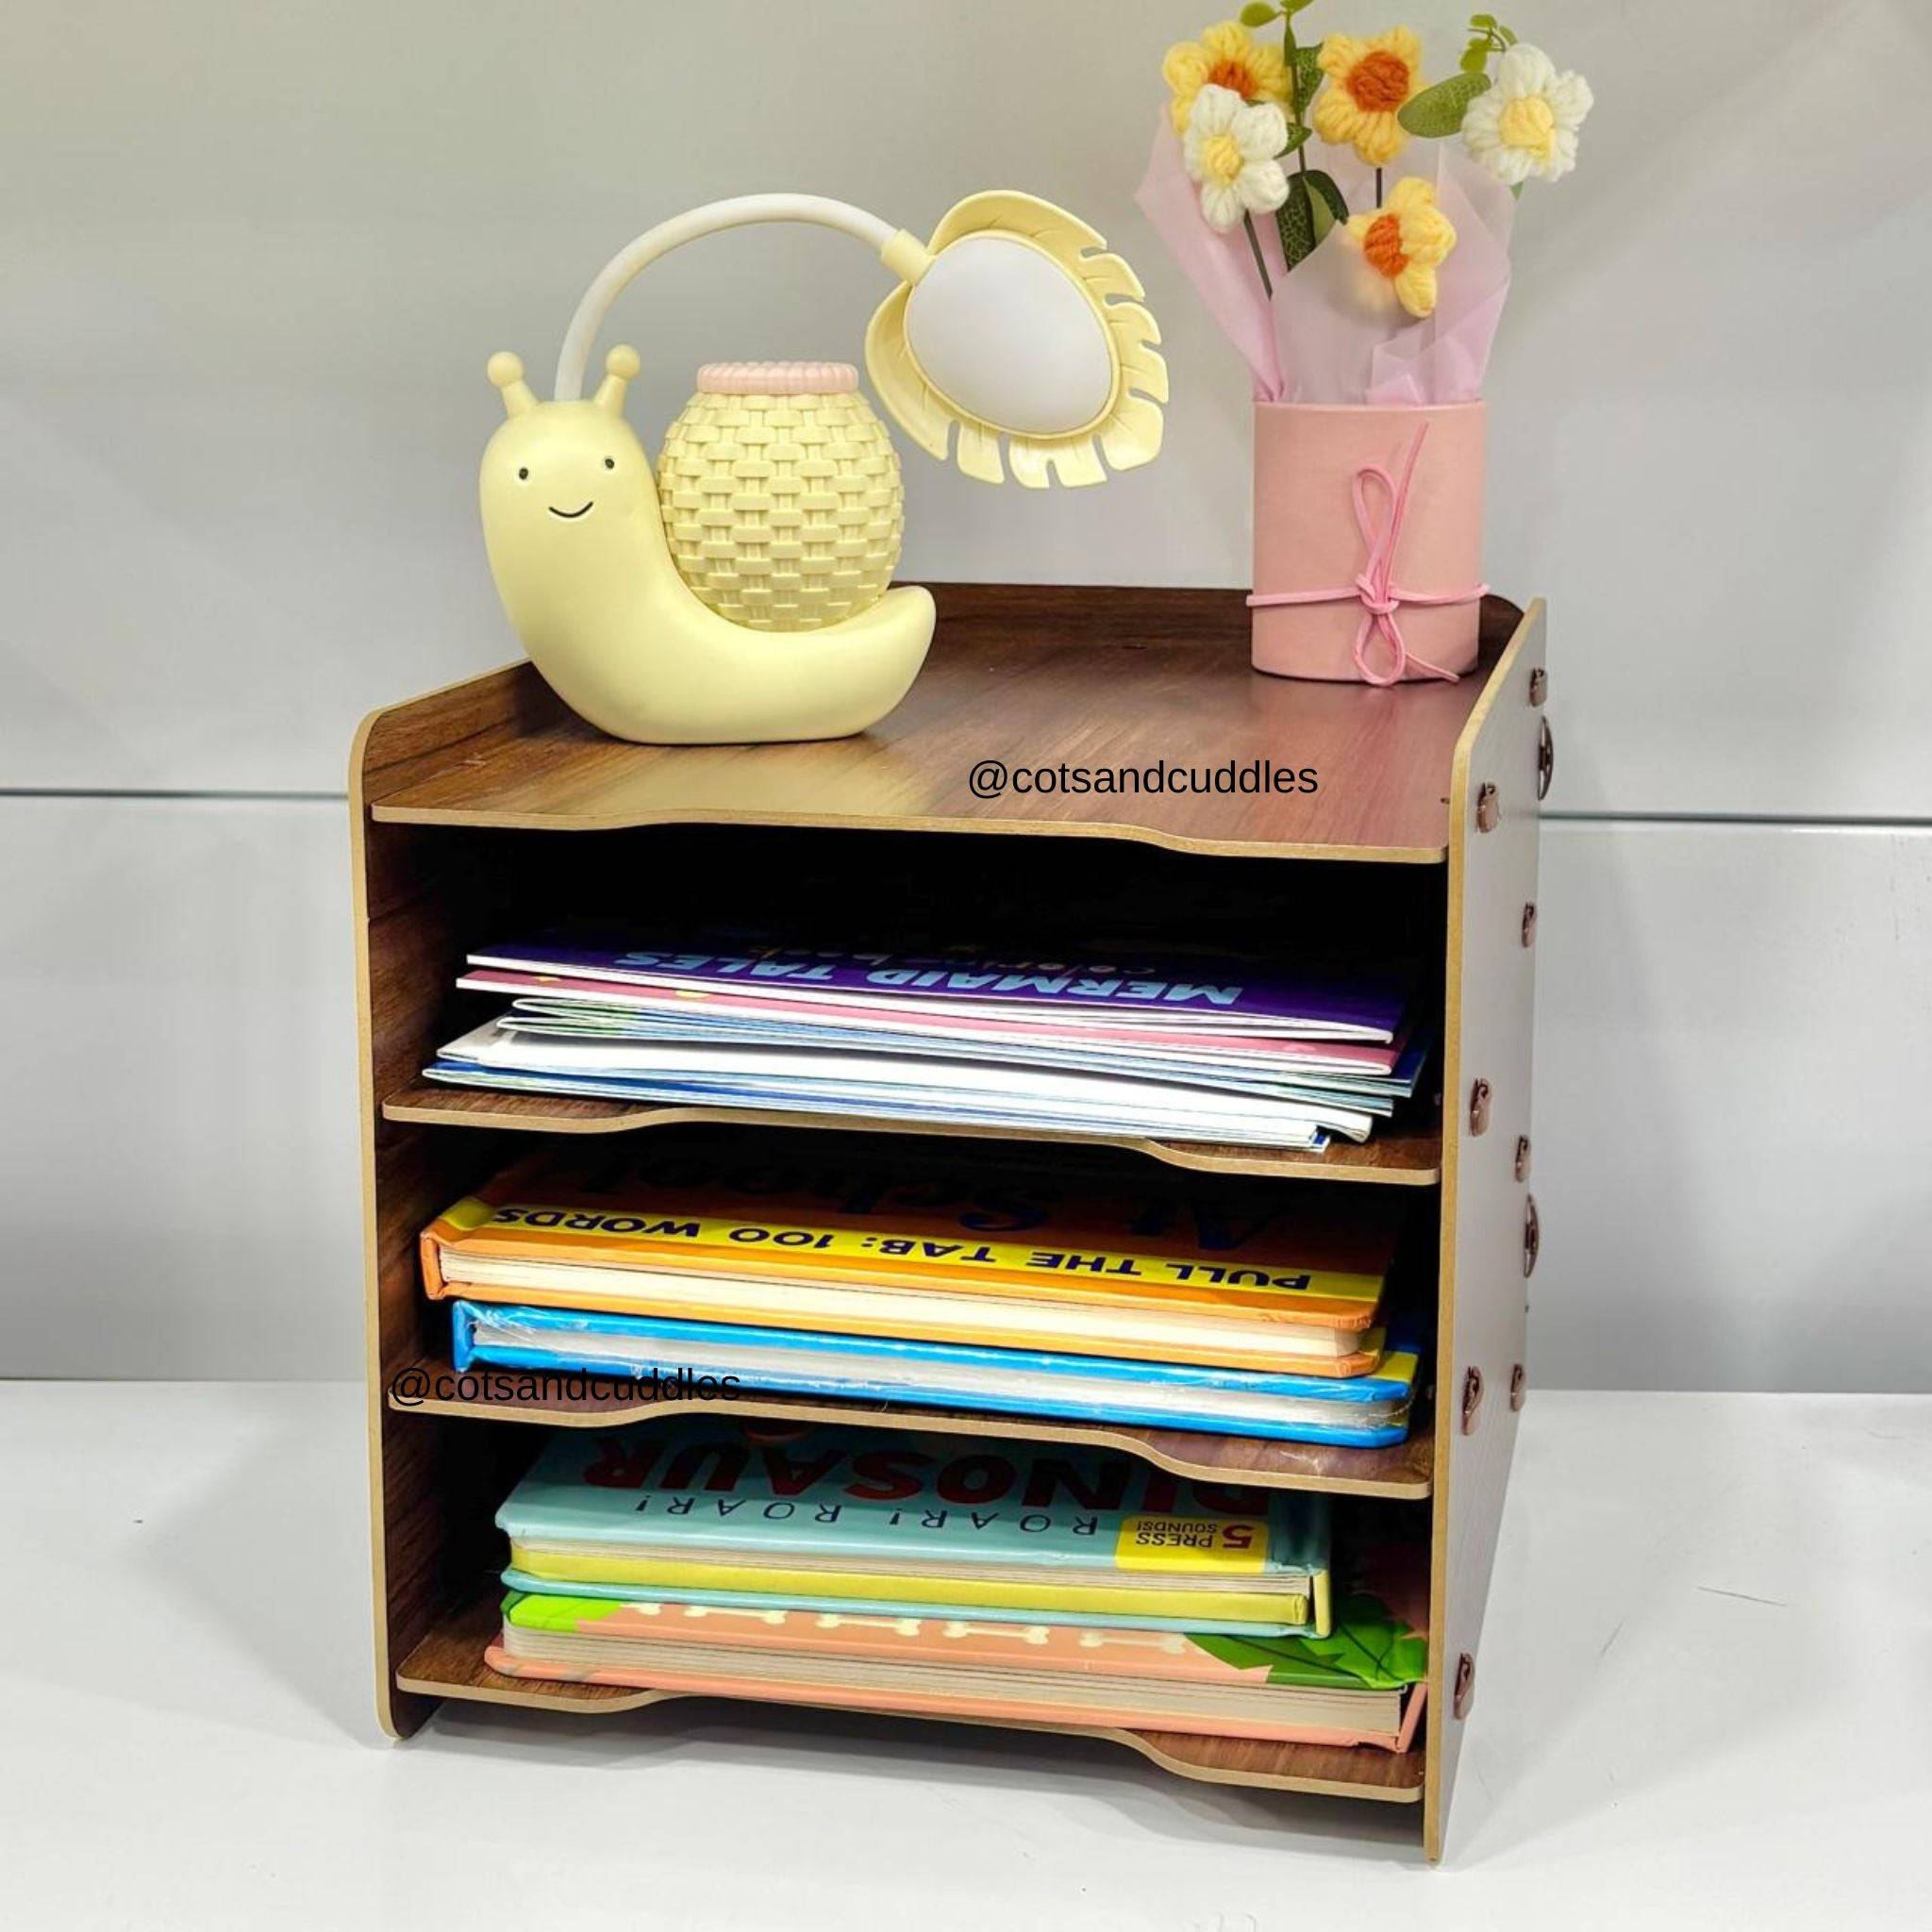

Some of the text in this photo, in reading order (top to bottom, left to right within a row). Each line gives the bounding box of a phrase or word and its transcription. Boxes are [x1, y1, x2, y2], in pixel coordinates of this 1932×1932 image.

[614, 950, 1245, 1005] MERMAID TALES
[492, 1208, 1311, 1291] PULL THE TAB: 100 WORDS
[635, 1494, 1099, 1537] ROAR! ROAR!
[1135, 1524, 1255, 1550] 5 PRESS
[1136, 1520, 1218, 1535] SOUNDS!
